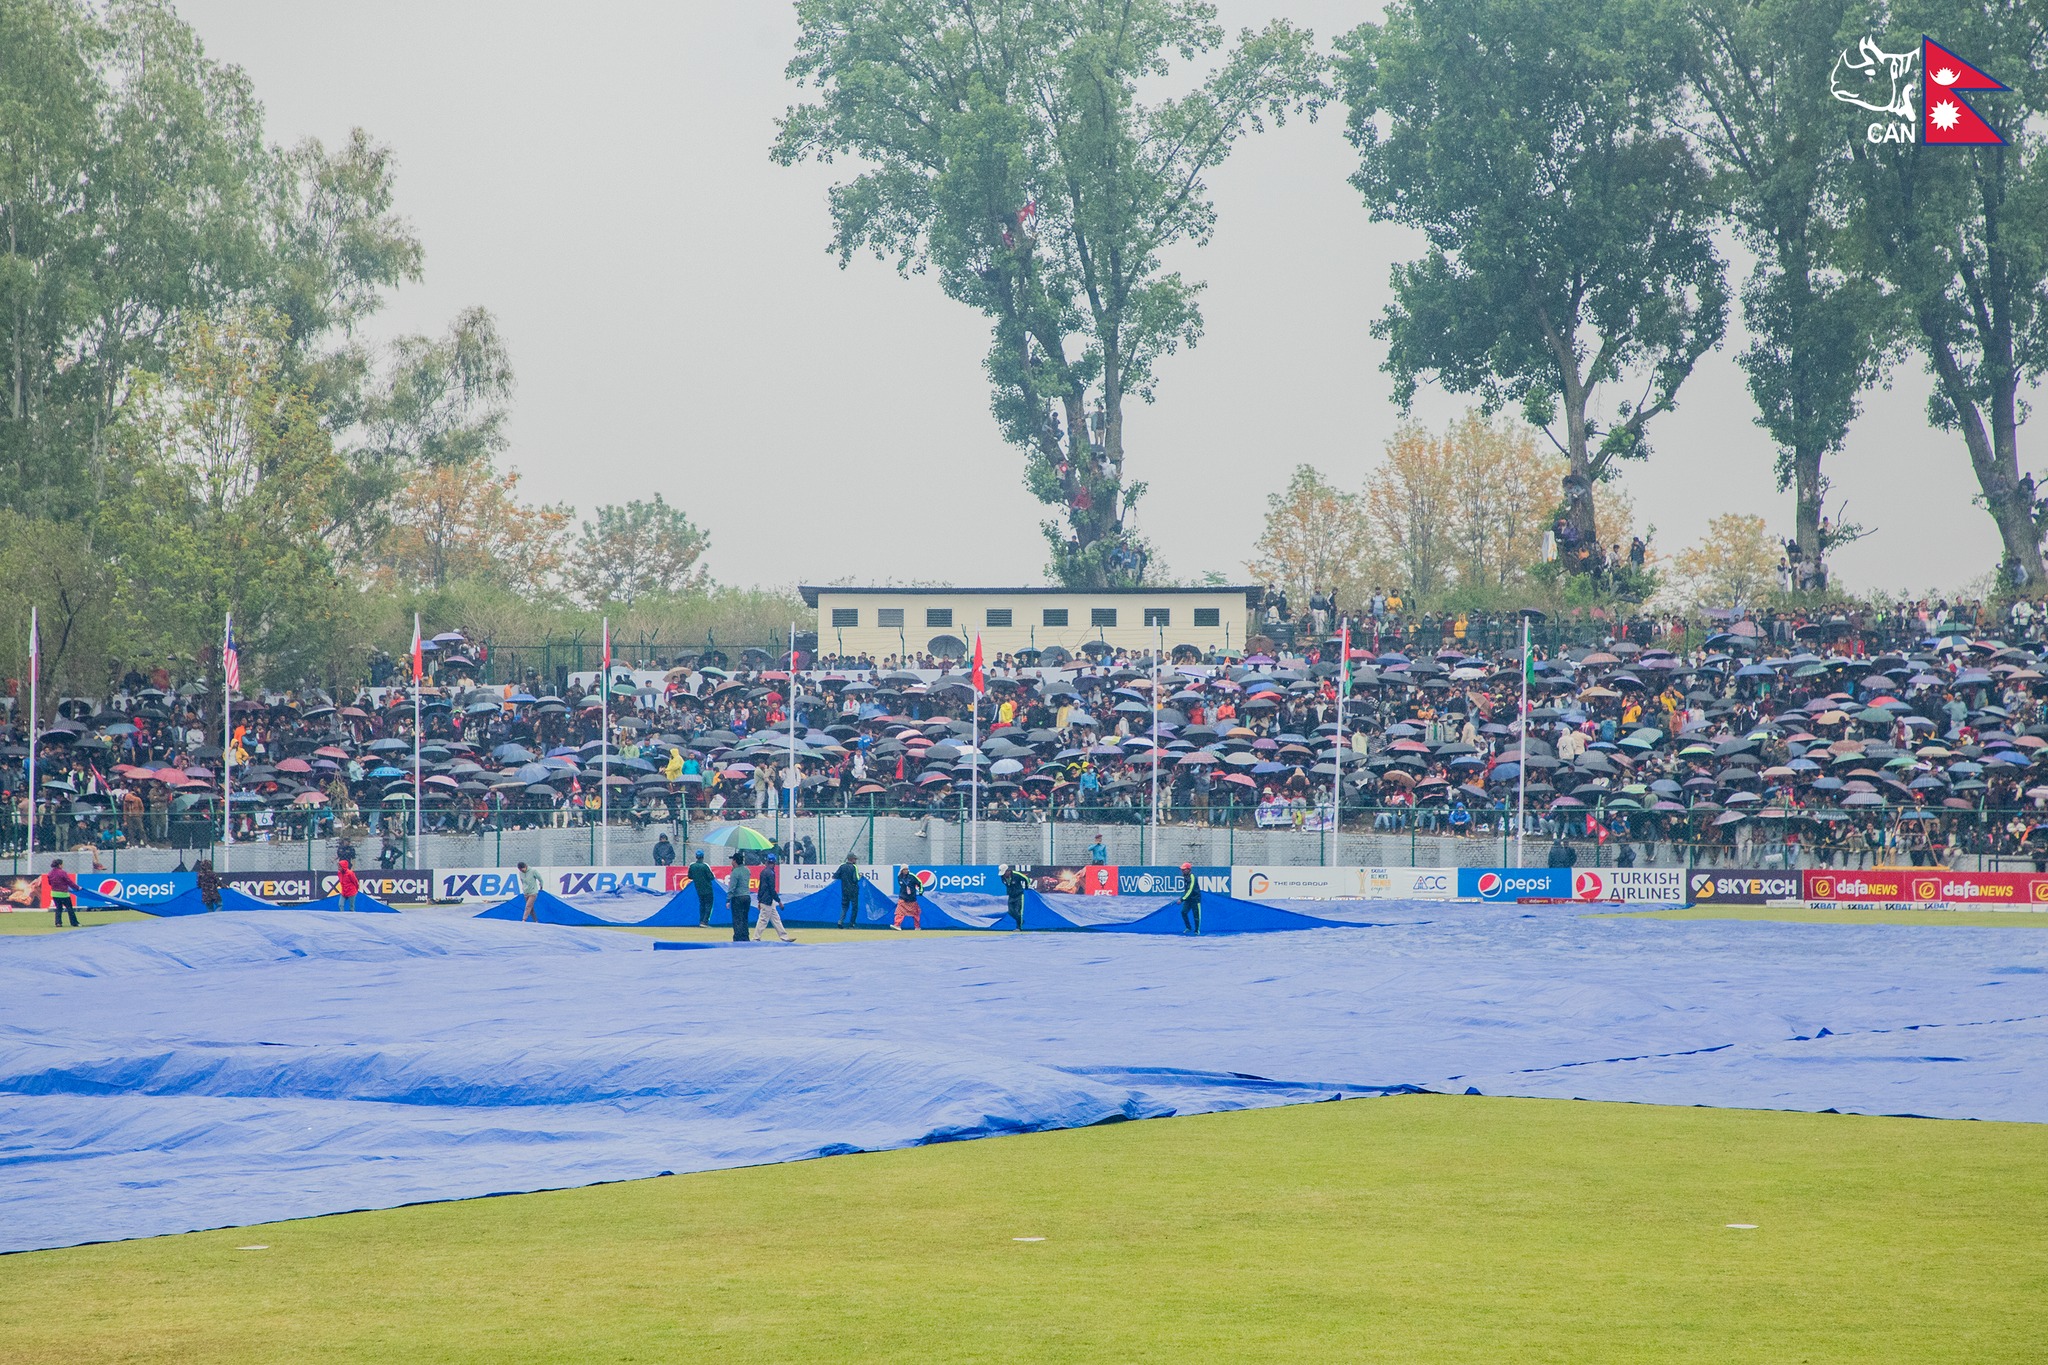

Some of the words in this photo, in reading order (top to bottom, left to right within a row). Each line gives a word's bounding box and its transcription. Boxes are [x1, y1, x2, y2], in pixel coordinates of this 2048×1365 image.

[358, 879, 429, 894] KYEXCH
[443, 874, 521, 896] 1XBA
[559, 873, 657, 895] 1XBAT
[940, 873, 985, 889] pepsi
[1120, 873, 1230, 893] WORLDINK
[1504, 876, 1552, 893] pepsi
[1610, 872, 1680, 885] TURKISH
[1717, 878, 1797, 895] SKYEXCH
[126, 881, 174, 899] pepsi
[229, 880, 310, 896] SKYEXCH
[1610, 887, 1680, 900] AIRLINES
[1836, 879, 1898, 897] dafaNEWS
[1943, 881, 2014, 899] dafaNEWS
[1885, 903, 1912, 911] 1XBAT
